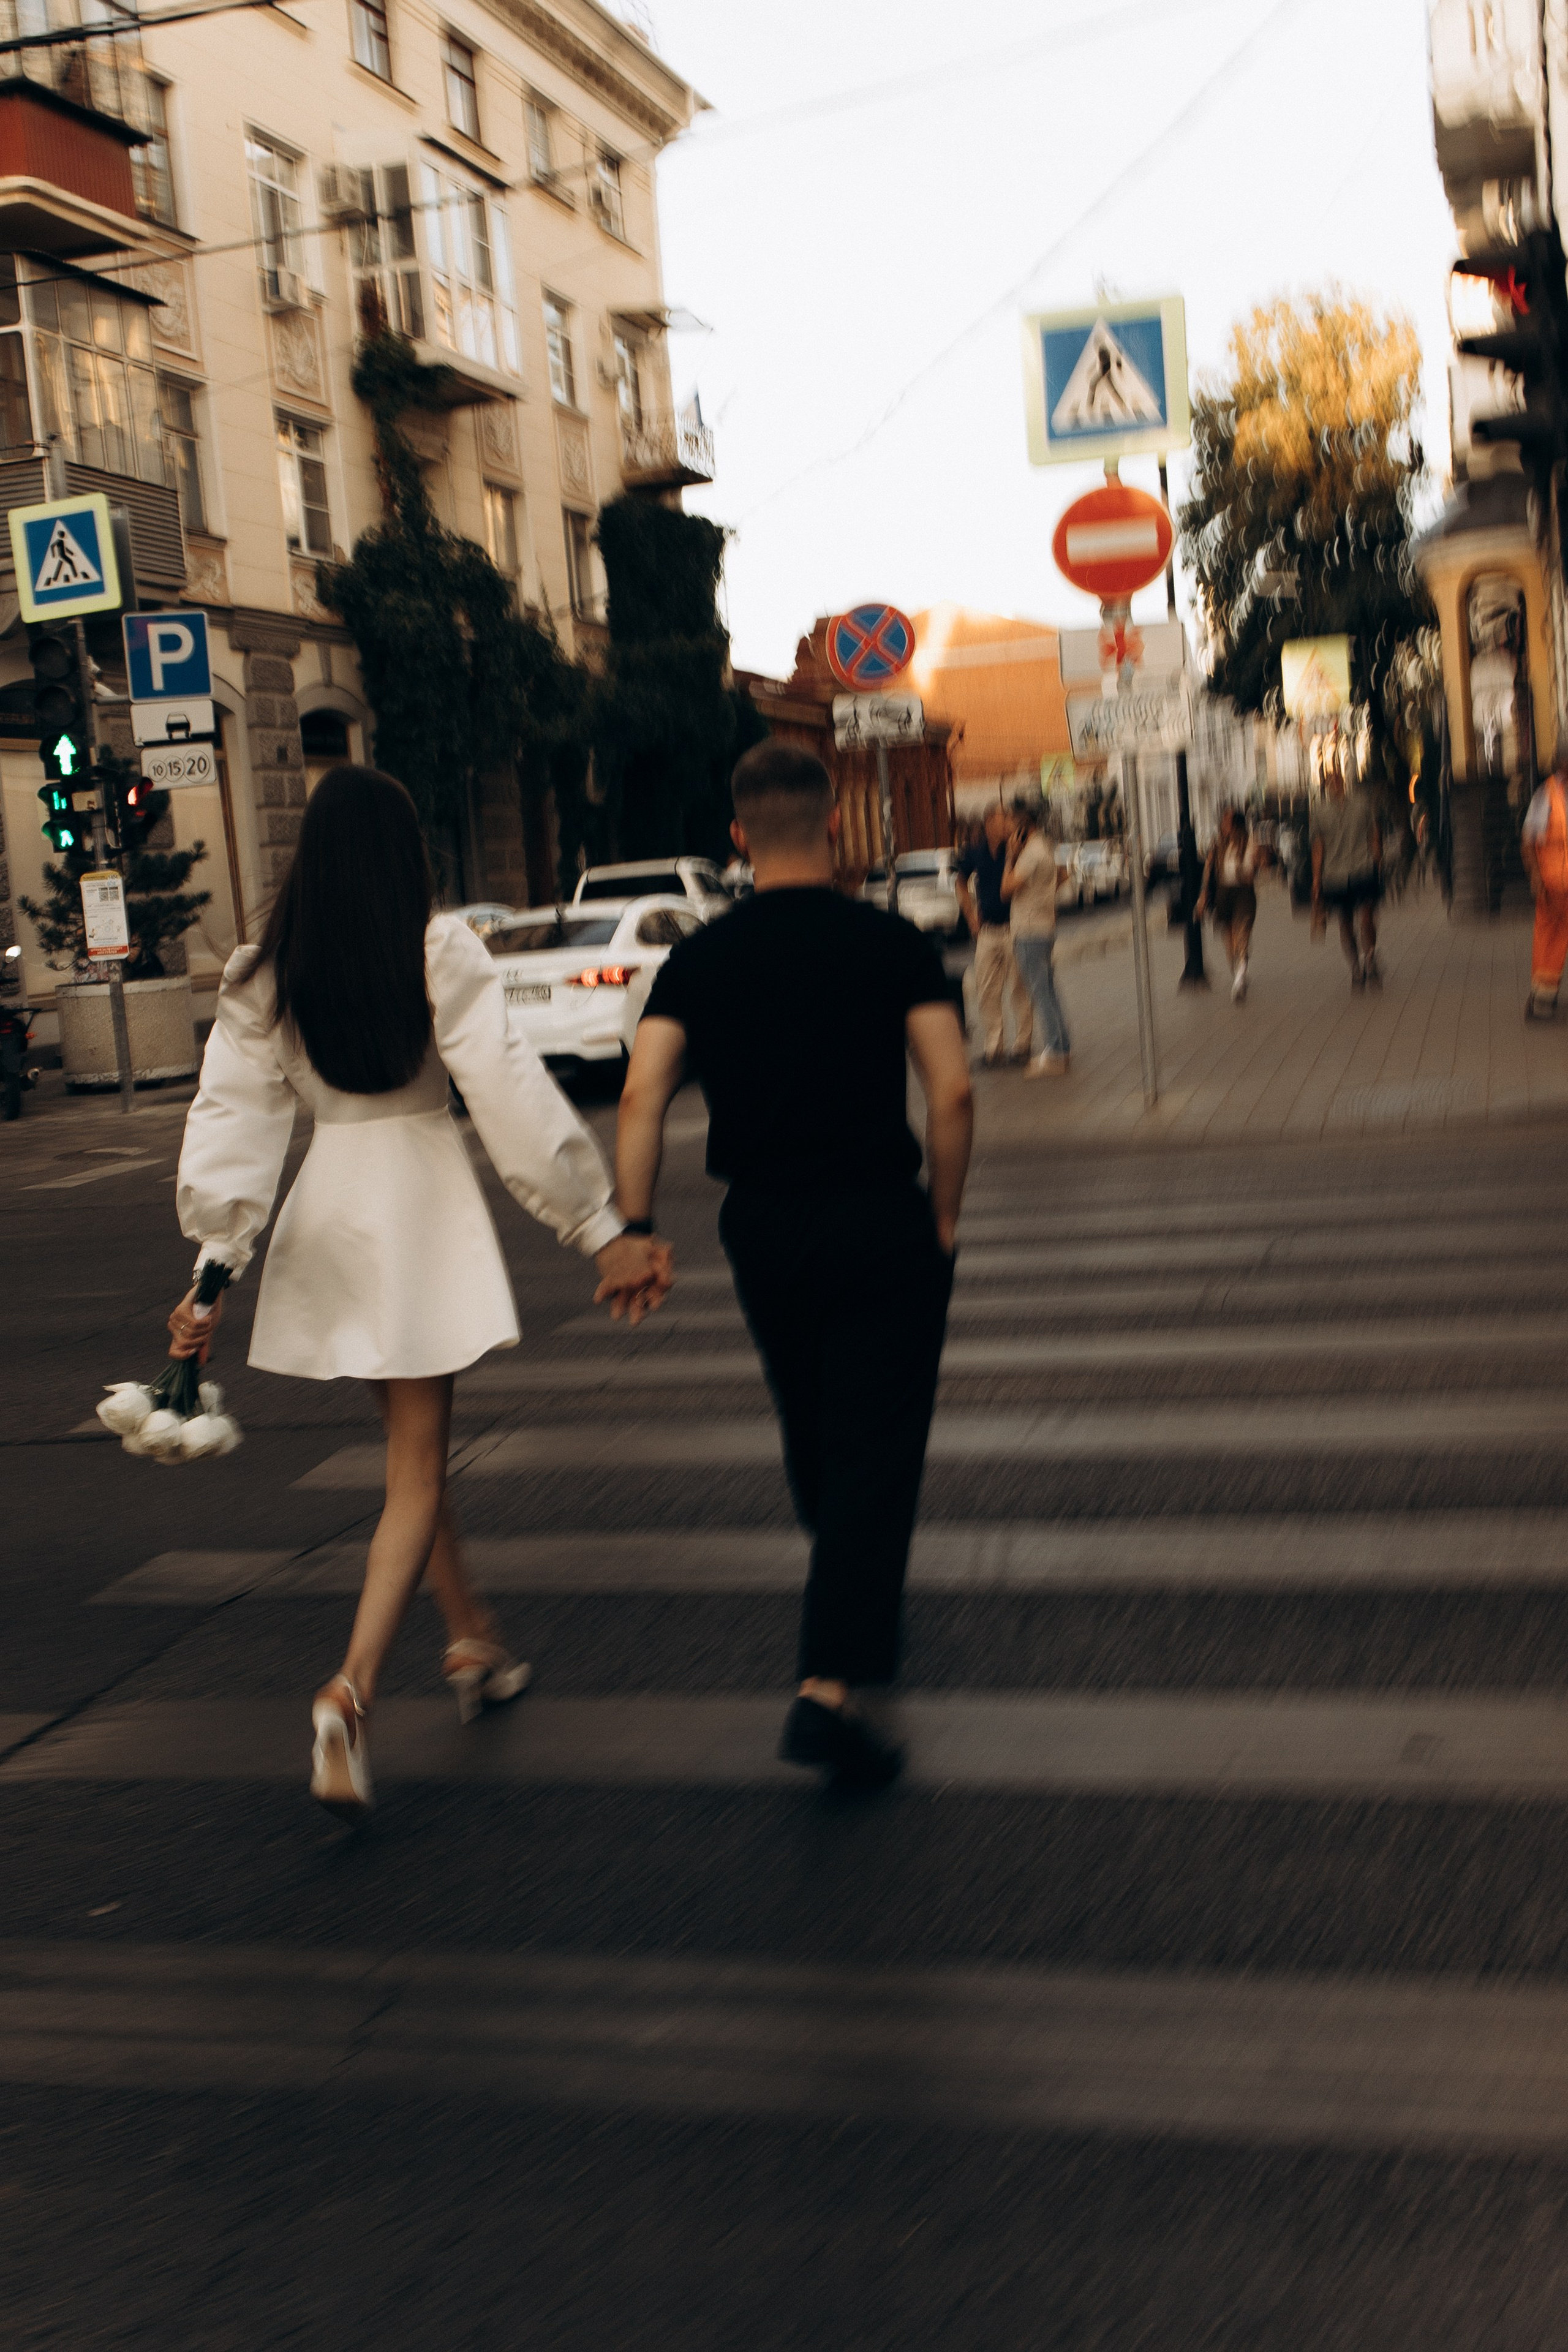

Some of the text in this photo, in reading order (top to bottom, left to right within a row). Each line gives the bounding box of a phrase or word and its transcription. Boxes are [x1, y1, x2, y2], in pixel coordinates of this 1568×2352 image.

[146, 622, 195, 691] P
[153, 756, 207, 776] 10 15 20
